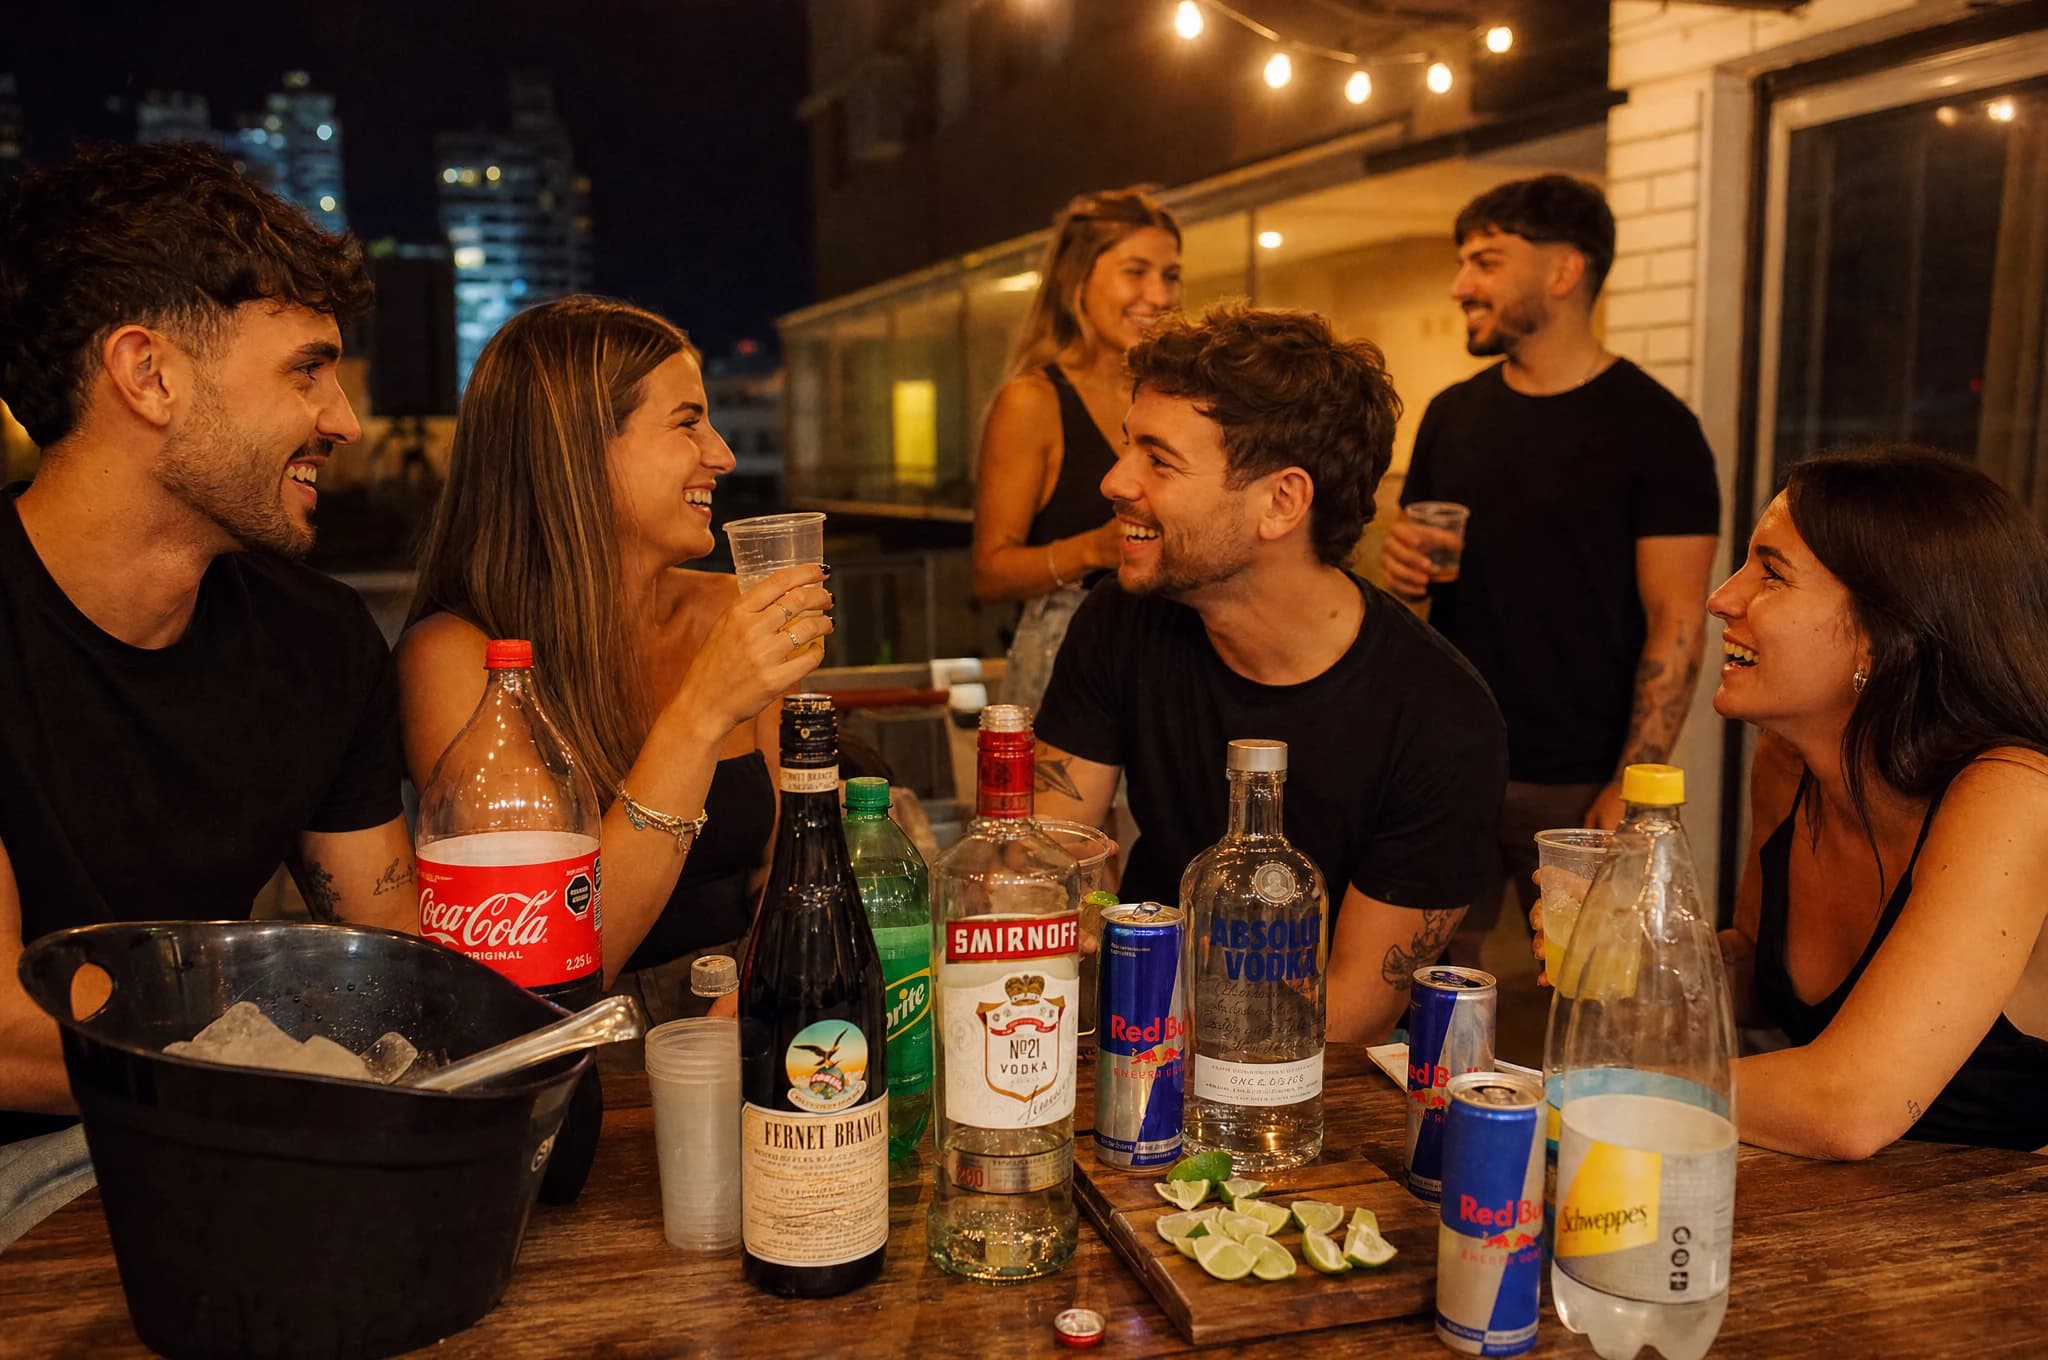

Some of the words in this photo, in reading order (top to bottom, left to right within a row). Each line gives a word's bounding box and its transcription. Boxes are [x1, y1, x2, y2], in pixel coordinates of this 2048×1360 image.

[420, 888, 558, 946] Coca-Cola
[1211, 914, 1322, 950] ABSOLUT
[955, 921, 1077, 954] SMIRNOFF
[1224, 949, 1316, 981] VODKA
[1111, 1014, 1160, 1043] Red
[1001, 1061, 1048, 1075] VODKA
[764, 1121, 826, 1150] FERNET
[835, 1110, 882, 1147] BRANCA
[1461, 1194, 1513, 1227] Red
[1562, 1204, 1648, 1235] Schweppes
